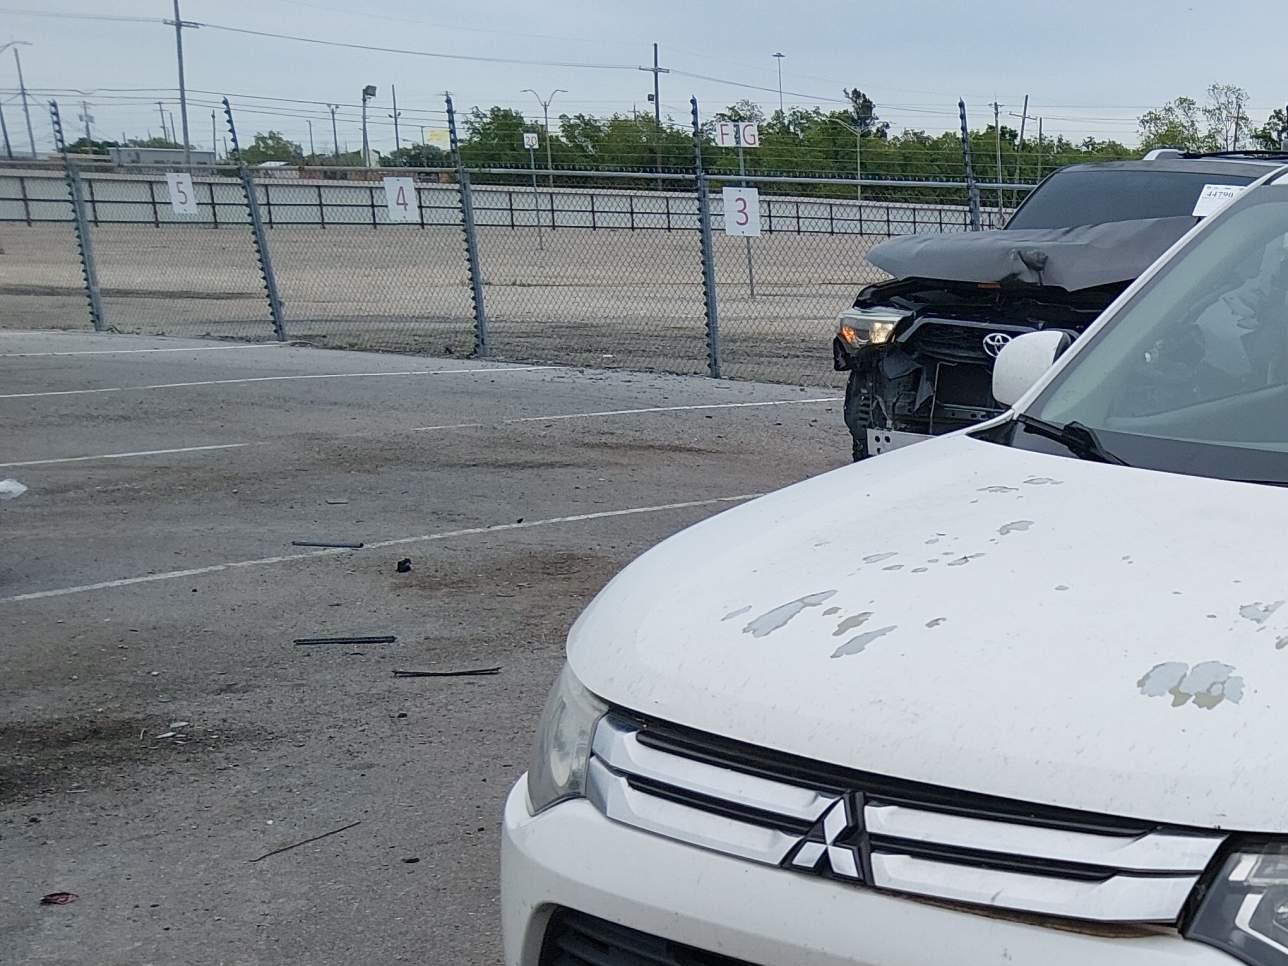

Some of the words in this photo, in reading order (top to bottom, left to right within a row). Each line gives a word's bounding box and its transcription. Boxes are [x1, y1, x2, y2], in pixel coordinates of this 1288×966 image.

[720, 123, 732, 145] F
[743, 123, 757, 145] G
[175, 180, 188, 205] 5
[395, 185, 409, 211] 4
[736, 197, 749, 225] 3
